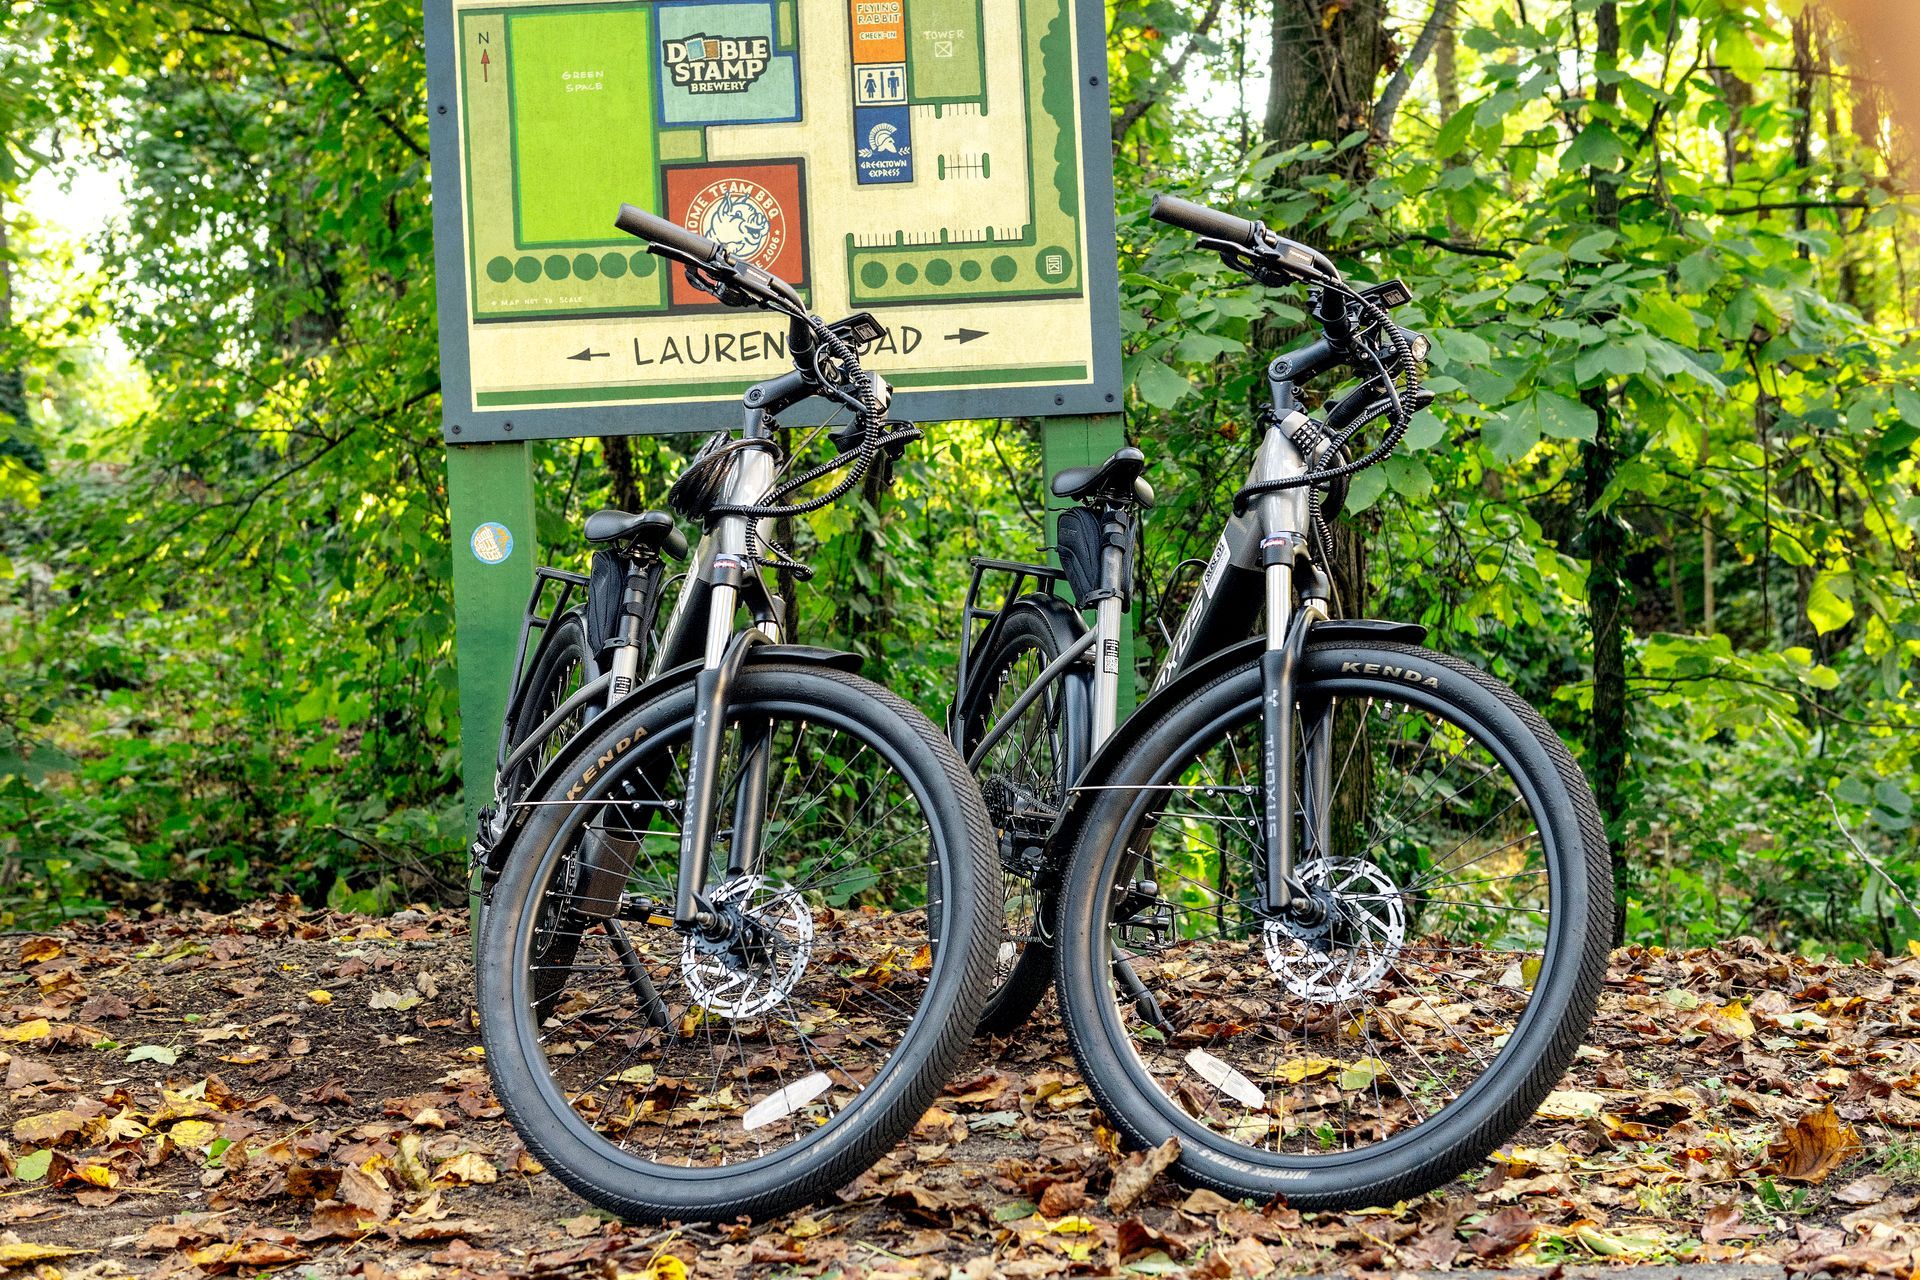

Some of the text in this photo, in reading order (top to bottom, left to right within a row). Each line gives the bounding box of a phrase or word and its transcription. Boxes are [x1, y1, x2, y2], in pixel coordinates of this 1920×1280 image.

[857, 2, 899, 13] FLYING
[857, 13, 900, 24] RABBIT
[478, 31, 490, 44] N
[860, 31, 897, 40] CHECK-IN
[923, 29, 965, 40] TOWER
[561, 70, 605, 80] GREEN
[675, 59, 764, 82] STAMP
[565, 82, 603, 93] SPACE
[690, 80, 747, 92] BREWERY
[860, 159, 908, 169] GREEKTOWN
[868, 168, 900, 178] EXPRESS
[708, 181, 754, 198] TEAM
[754, 191, 780, 219] BBQ
[762, 236, 781, 262] 2006
[501, 299, 520, 307] MAP
[559, 296, 584, 304] SCALE
[634, 330, 785, 366] LAUREN
[1341, 661, 1439, 689] KENDA
[566, 726, 649, 801] KENDA
[1264, 734, 1279, 839] TROXUS
